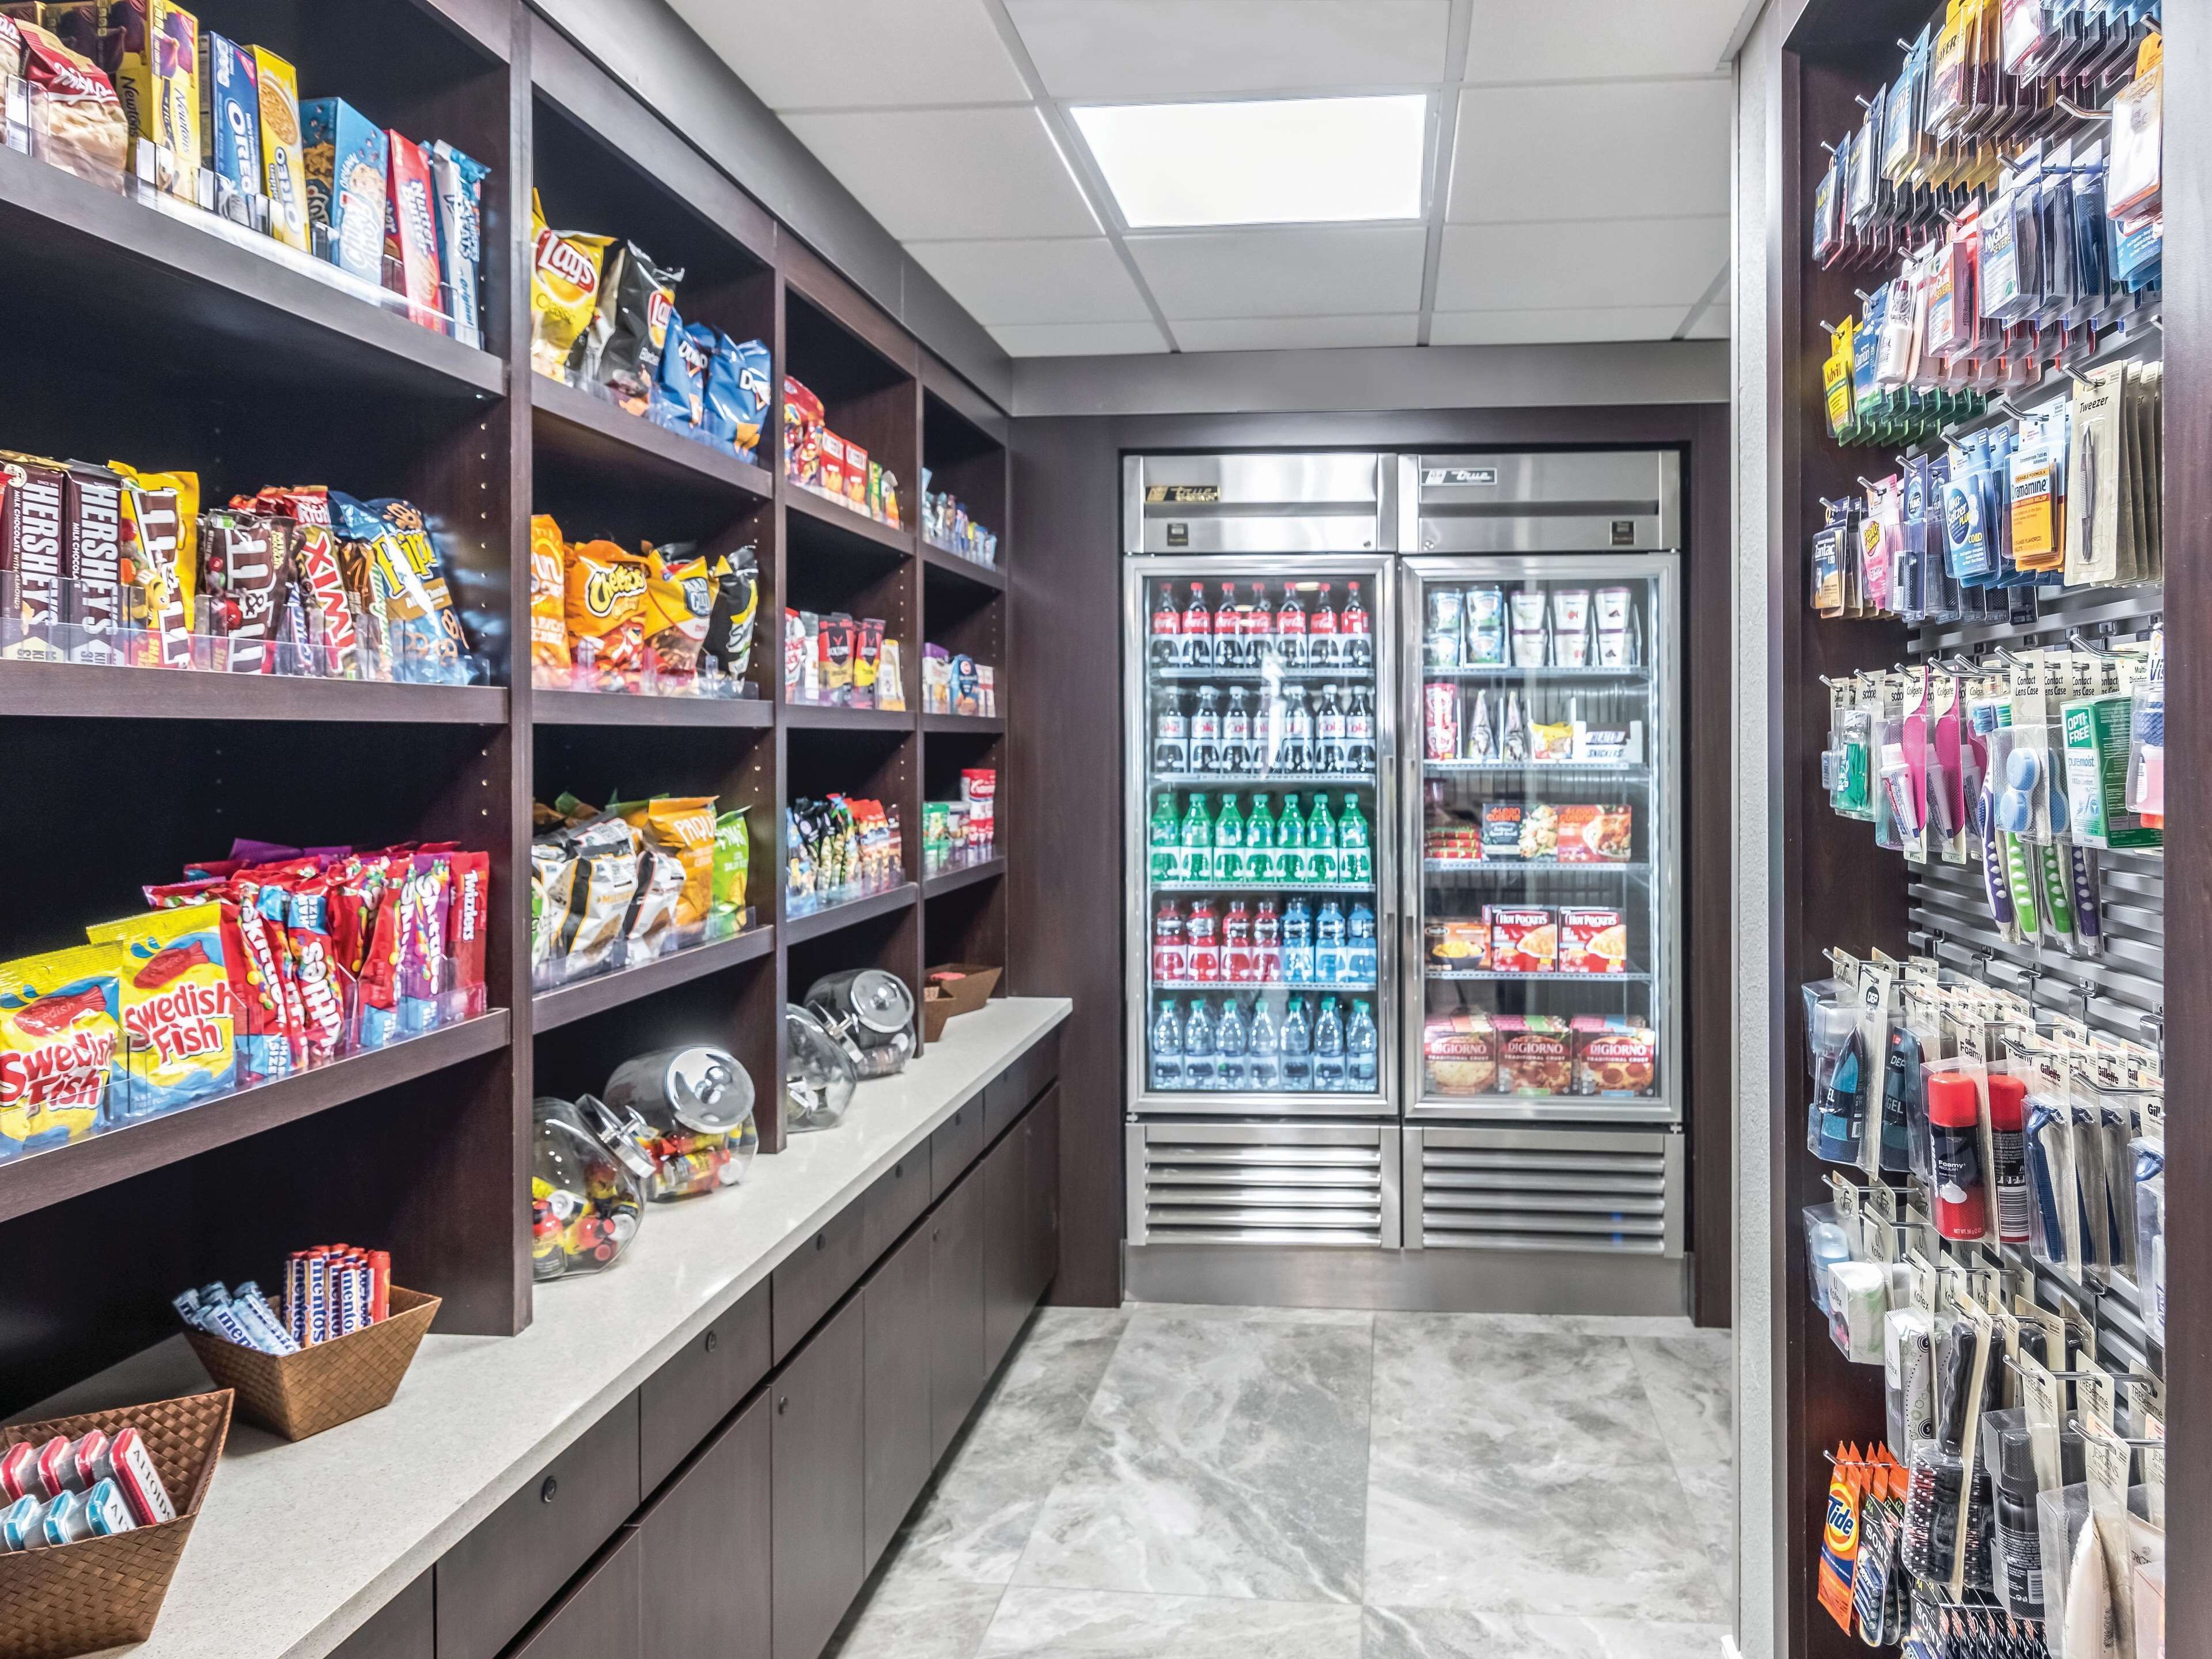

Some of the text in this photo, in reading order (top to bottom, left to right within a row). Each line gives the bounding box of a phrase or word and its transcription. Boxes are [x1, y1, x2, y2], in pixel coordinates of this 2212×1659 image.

[1936, 35, 1957, 66] AYER
[120, 76, 139, 137] Newtons
[174, 87, 190, 154] Newtons
[226, 100, 252, 193] OREO
[268, 163, 279, 202] olden
[275, 146, 303, 234] OREO
[401, 185, 429, 257] Butter
[411, 181, 435, 253] Nutter
[1984, 221, 2009, 252] NyQuil
[1993, 233, 2011, 256] SEVERE
[460, 278, 474, 327] Original
[1936, 281, 1952, 301] SEVERE
[536, 293, 575, 325] Classic
[1827, 362, 1842, 385] Advil
[2080, 395, 2109, 414] Tweezer
[1451, 469, 1493, 481] true
[2011, 478, 2048, 500] Dramamine
[1909, 497, 1921, 510] TUMS
[1948, 502, 1967, 527] Seltzer
[14, 507, 22, 552] CHOCOLATE
[1959, 512, 1971, 527] PLU
[21, 482, 59, 626] HERSHEY'S
[71, 522, 81, 589] MILK CHOCOLATE
[81, 485, 119, 635] HERSHEY'S
[1827, 555, 1835, 565] 150
[14, 569, 22, 610] ALMONDS
[588, 565, 647, 615] Cheetos
[300, 530, 357, 674] TWIX
[1907, 686, 1922, 697] Colgate
[2016, 687, 2039, 696] Lens Case
[2017, 676, 2036, 685] Contact
[2045, 687, 2066, 696] ens Case
[2073, 687, 2094, 696] ens Case
[2101, 676, 2118, 685] ontact
[1862, 689, 1876, 702] scope
[1937, 687, 1954, 698] Colgate
[1969, 687, 1984, 698] Colga
[2067, 711, 2088, 731] OPTI-
[2069, 725, 2090, 745] FREE
[2069, 756, 2095, 771] puremoist
[463, 870, 479, 941] Twizzlers
[301, 941, 341, 1050] kittles
[1866, 991, 1878, 1004] DEP
[124, 982, 233, 1036] Swedish
[152, 1023, 221, 1065] Fish
[1960, 1041, 1983, 1065] Foamy
[0, 1032, 113, 1100] Swedish
[1891, 1055, 1906, 1068] DEP
[2040, 1063, 2061, 1082] Gillette
[2097, 1066, 2119, 1084] Gillette
[2127, 1068, 2138, 1081] Gill
[28, 1070, 101, 1108] Fish
[1827, 1089, 1835, 1104] EL
[1886, 1097, 1903, 1115] GEL
[1938, 1160, 1963, 1169] Foamy
[1872, 1242, 1884, 1263] kotex
[312, 1259, 327, 1344] mentos
[342, 1271, 354, 1335] mento
[1830, 1288, 1842, 1308] kotex
[1914, 1290, 1929, 1312] kotex
[1977, 1289, 1989, 1308] kote
[1886, 1357, 1897, 1377] kotex
[2092, 1445, 2119, 1478] JERGENS
[1828, 1495, 1854, 1536] Tide
[1865, 1524, 1889, 1568] SONY
[1859, 1565, 1873, 1588] SONY
[1916, 1601, 1942, 1655] SONY
[1972, 1615, 1994, 1658] ONY
